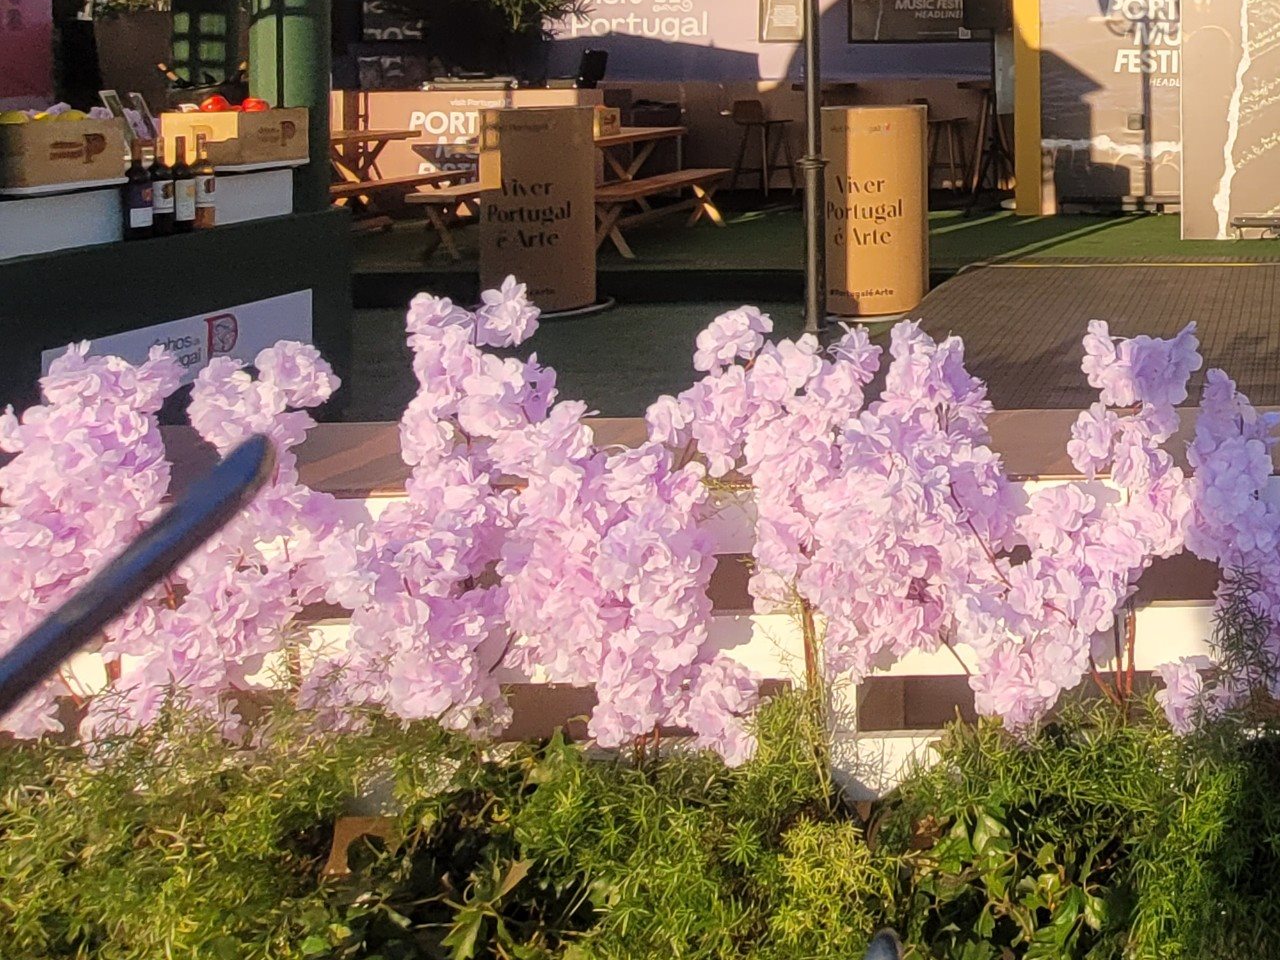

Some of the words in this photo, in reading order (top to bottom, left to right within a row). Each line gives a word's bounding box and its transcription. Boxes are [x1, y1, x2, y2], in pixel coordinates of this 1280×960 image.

[895, 0, 935, 10] MUSIC
[937, 0, 963, 10] FESTI
[571, 10, 709, 43] Portugal
[1114, 49, 1180, 74] FESTI
[408, 110, 480, 135] PORT
[501, 178, 554, 197] Viver
[836, 174, 886, 194] Viver
[487, 200, 572, 224] Portugal
[827, 198, 903, 225] Portugal
[517, 229, 560, 248] Arte
[834, 227, 845, 247] é
[852, 227, 892, 246] Arte
